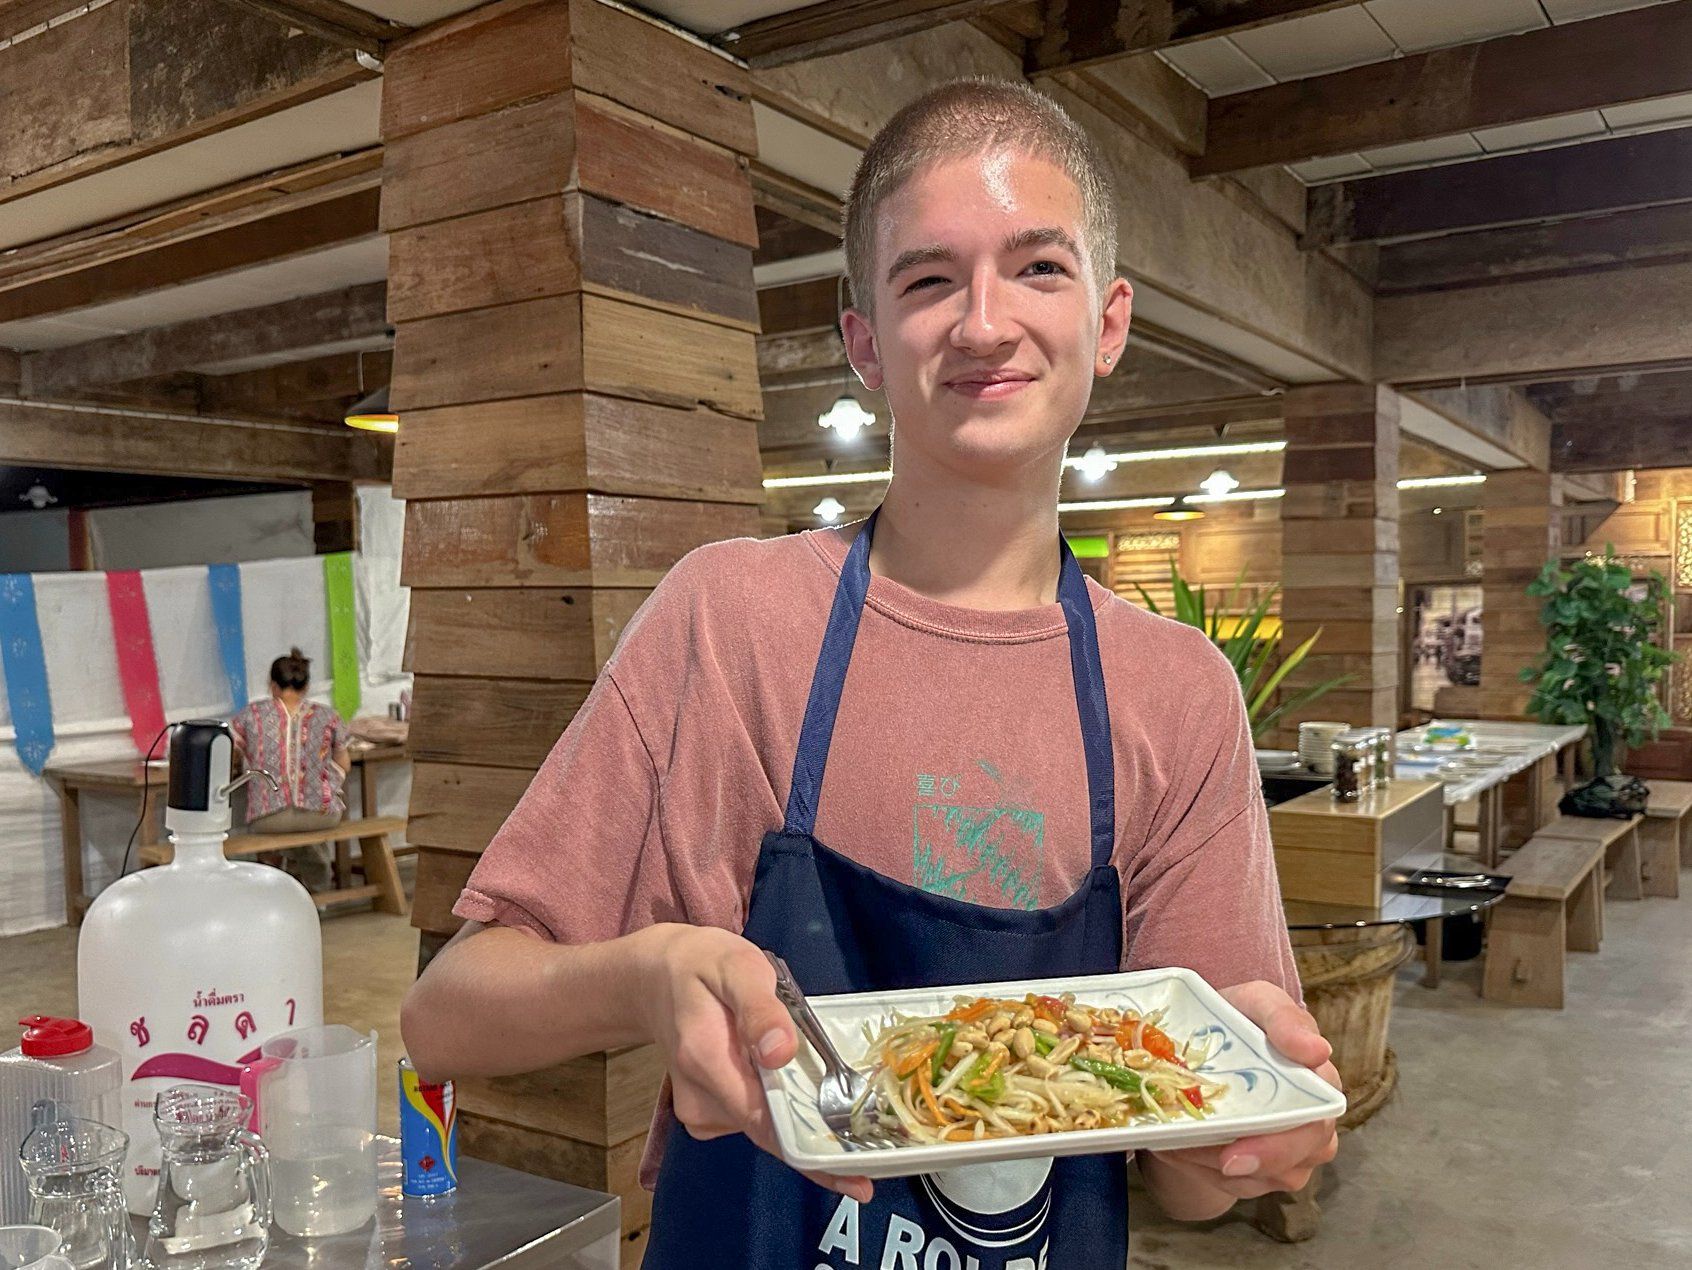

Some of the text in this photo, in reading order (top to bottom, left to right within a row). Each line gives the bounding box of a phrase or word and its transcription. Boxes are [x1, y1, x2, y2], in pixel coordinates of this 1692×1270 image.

[193, 988, 245, 1008] น้ำดื่มตรา
[818, 1194, 860, 1265] A
[880, 1213, 980, 1270] RO
